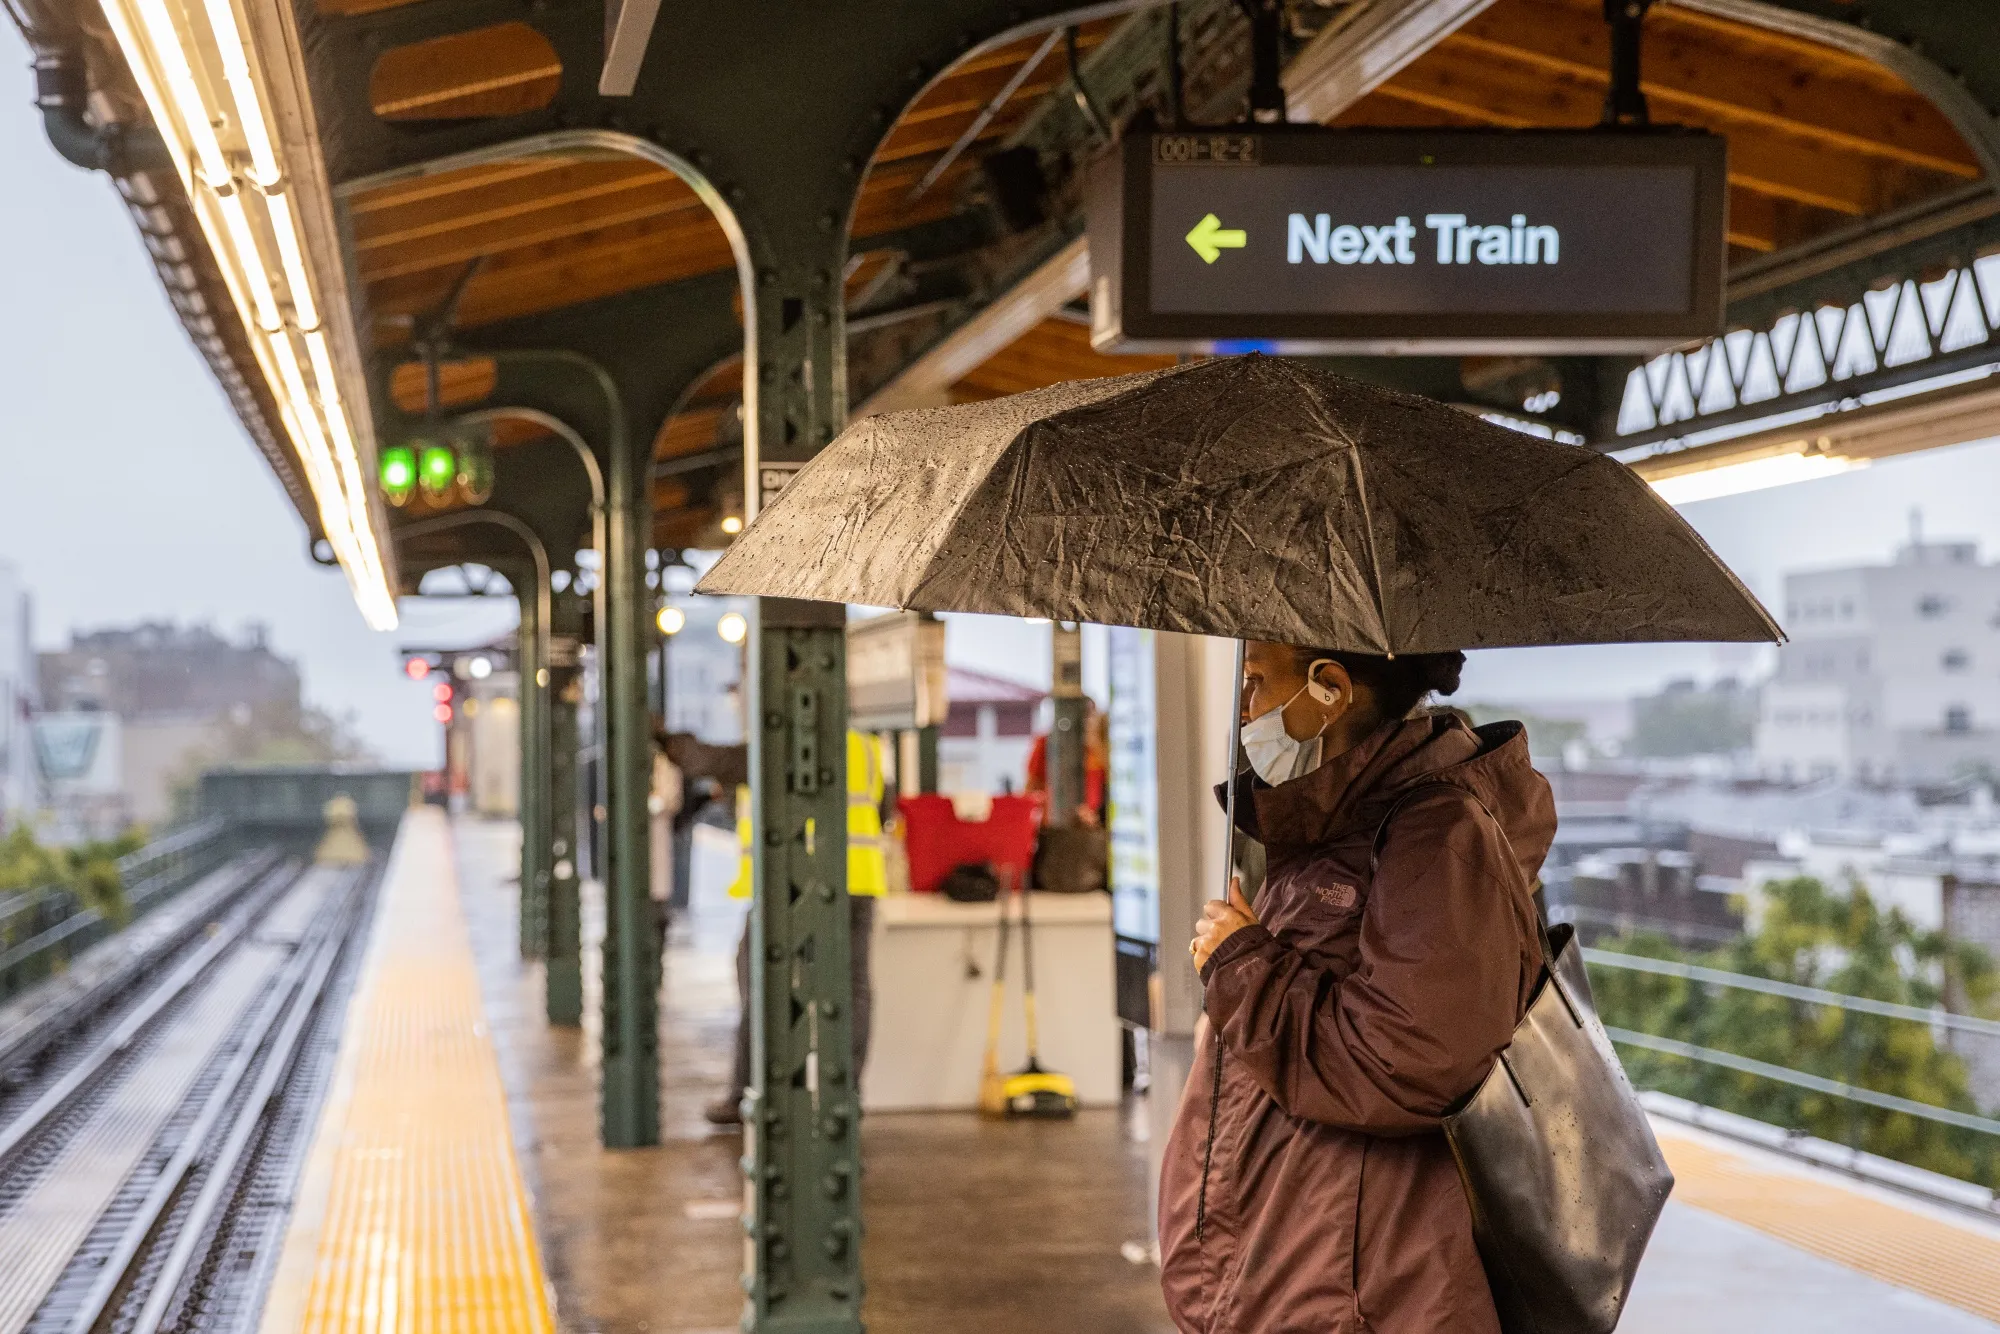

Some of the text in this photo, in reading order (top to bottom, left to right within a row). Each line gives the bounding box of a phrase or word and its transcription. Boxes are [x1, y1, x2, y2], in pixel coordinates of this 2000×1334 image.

[1160, 136, 1254, 161] 001-12-2
[1286, 212, 1559, 265] Next Train
[1315, 886, 1345, 899] NORTH
[1332, 882, 1348, 892] THE
[1320, 895, 1342, 906] FACE
